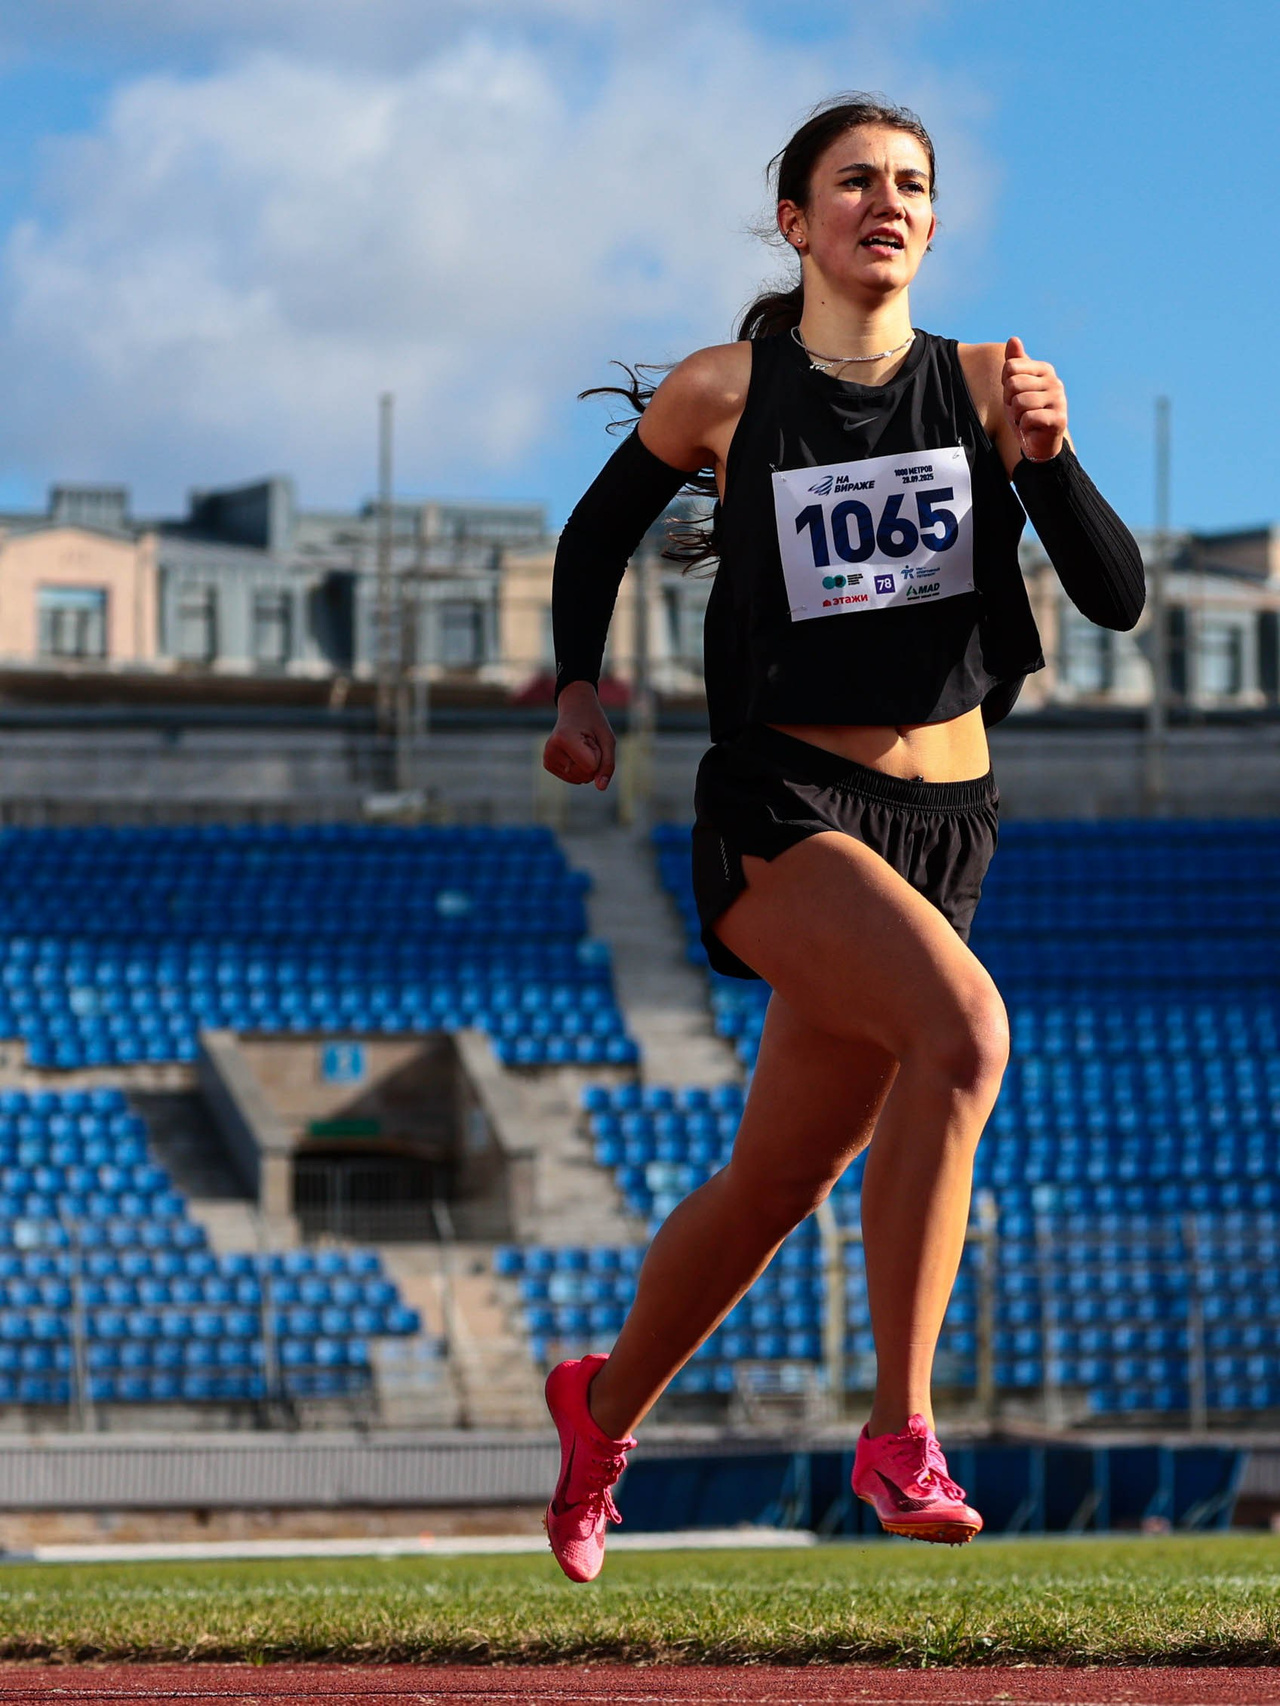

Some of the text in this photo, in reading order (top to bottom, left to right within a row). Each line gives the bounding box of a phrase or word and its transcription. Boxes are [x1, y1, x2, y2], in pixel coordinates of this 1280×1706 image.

[908, 465, 933, 475] МЕТРОВ
[836, 475, 849, 484] НА
[834, 480, 875, 493] ВИРАЖЕ
[795, 487, 959, 568] 1065
[877, 578, 892, 591] 78
